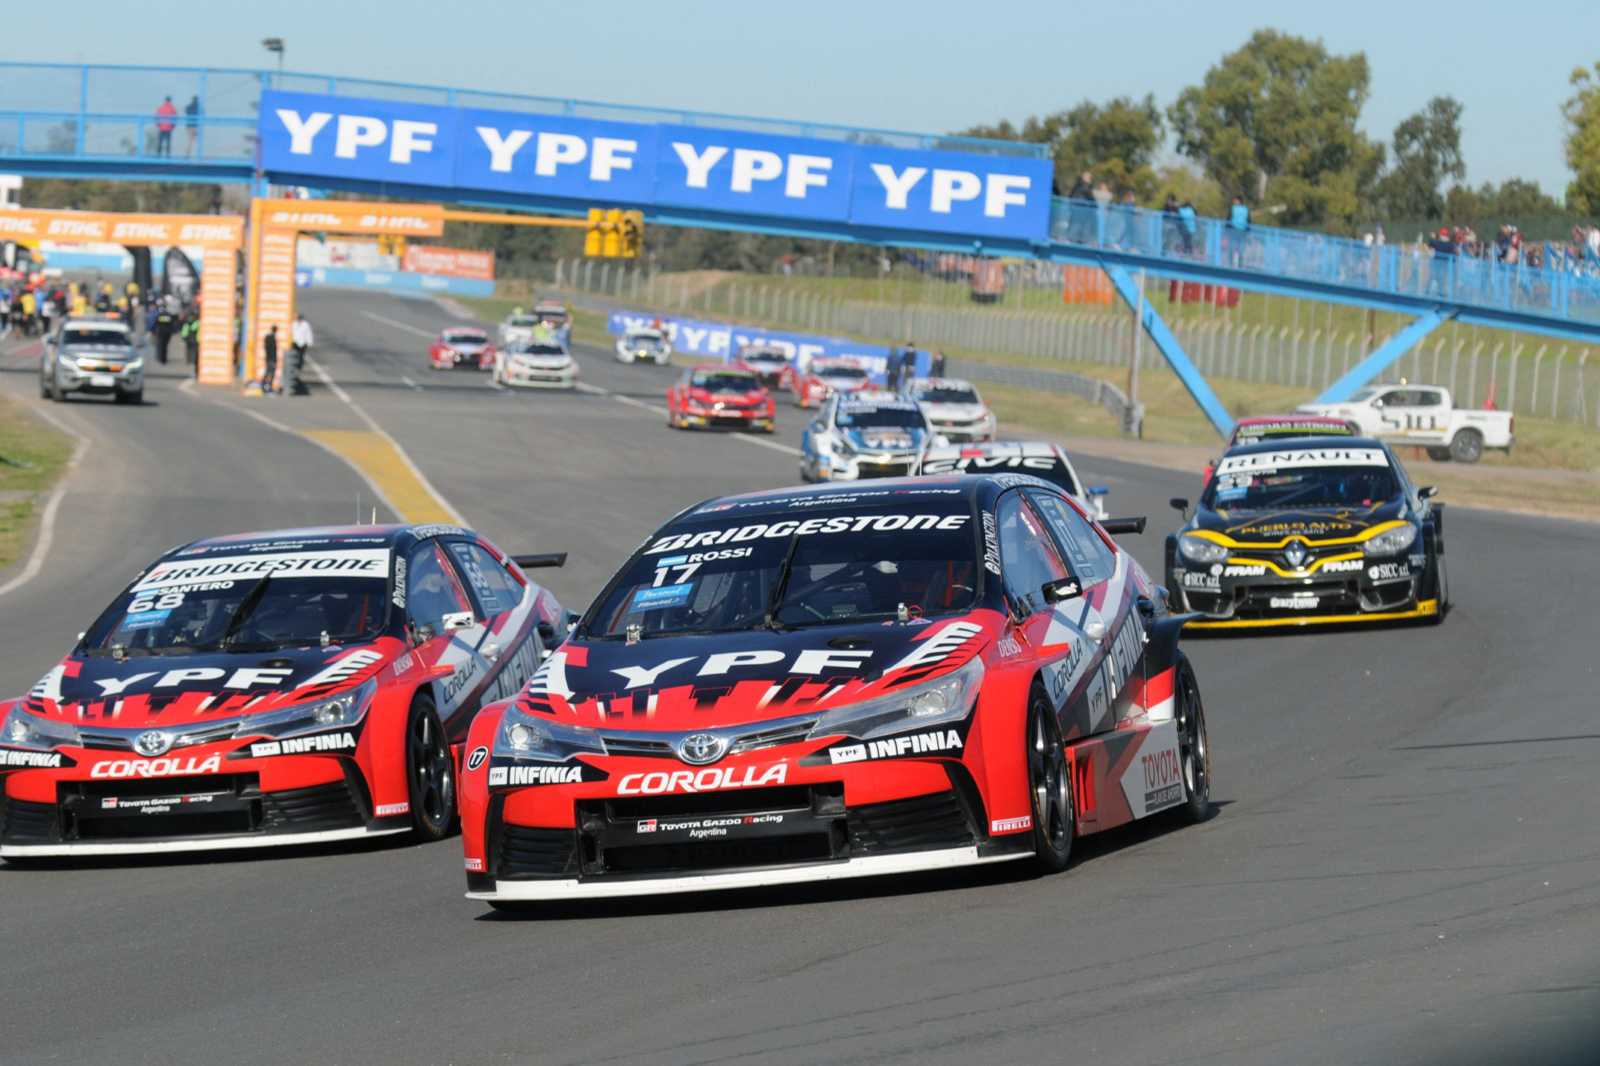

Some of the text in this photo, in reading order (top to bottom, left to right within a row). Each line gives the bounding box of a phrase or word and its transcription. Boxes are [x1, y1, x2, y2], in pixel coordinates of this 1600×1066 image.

[275, 109, 438, 164] YPF
[475, 126, 638, 182] YPF
[671, 141, 833, 199] YPF
[870, 163, 1031, 218] YPF
[0, 217, 37, 234] TIHL
[48, 219, 104, 237] STIHL
[113, 222, 169, 239] STIHL
[179, 224, 236, 240] STIHL
[923, 456, 1057, 474] CIVIC
[1227, 451, 1378, 469] RENAULT
[738, 496, 813, 508] TOYOTA
[818, 491, 890, 500] GAZOO
[789, 497, 858, 507] Argentina
[643, 514, 971, 555] BRIDGESTONE
[982, 510, 999, 565] PILKINGTON
[688, 547, 753, 563] ROSSI
[143, 557, 386, 585] BRIDGESTONE
[652, 562, 703, 588] 17
[1224, 565, 1266, 577] FRAM
[1323, 560, 1364, 572] FRAM
[1380, 563, 1399, 578] SICC
[158, 580, 235, 595] SANTERO
[127, 592, 186, 614] 68
[997, 637, 1022, 658] DENSO
[393, 652, 414, 676] DENSO
[609, 650, 874, 689] YPF
[1053, 637, 1083, 700] COROLLA
[94, 667, 294, 697] YPF
[443, 657, 477, 706] COROLLA
[281, 732, 357, 754] INFINIA
[836, 729, 963, 759] YPF INFINIA
[7, 750, 62, 768] INFINIA
[90, 756, 221, 778] COROLLA
[469, 750, 484, 766] 17
[509, 766, 583, 785] INFINIA
[1142, 748, 1180, 789] TOYOTA
[617, 764, 788, 794] COROLLA
[119, 800, 150, 808] TOYOTA
[140, 805, 170, 814] Argentina
[637, 815, 783, 833] GR TOYOTA GAZOO Racing
[689, 828, 727, 838] Argentina
[992, 815, 1031, 832] PIRELLI
